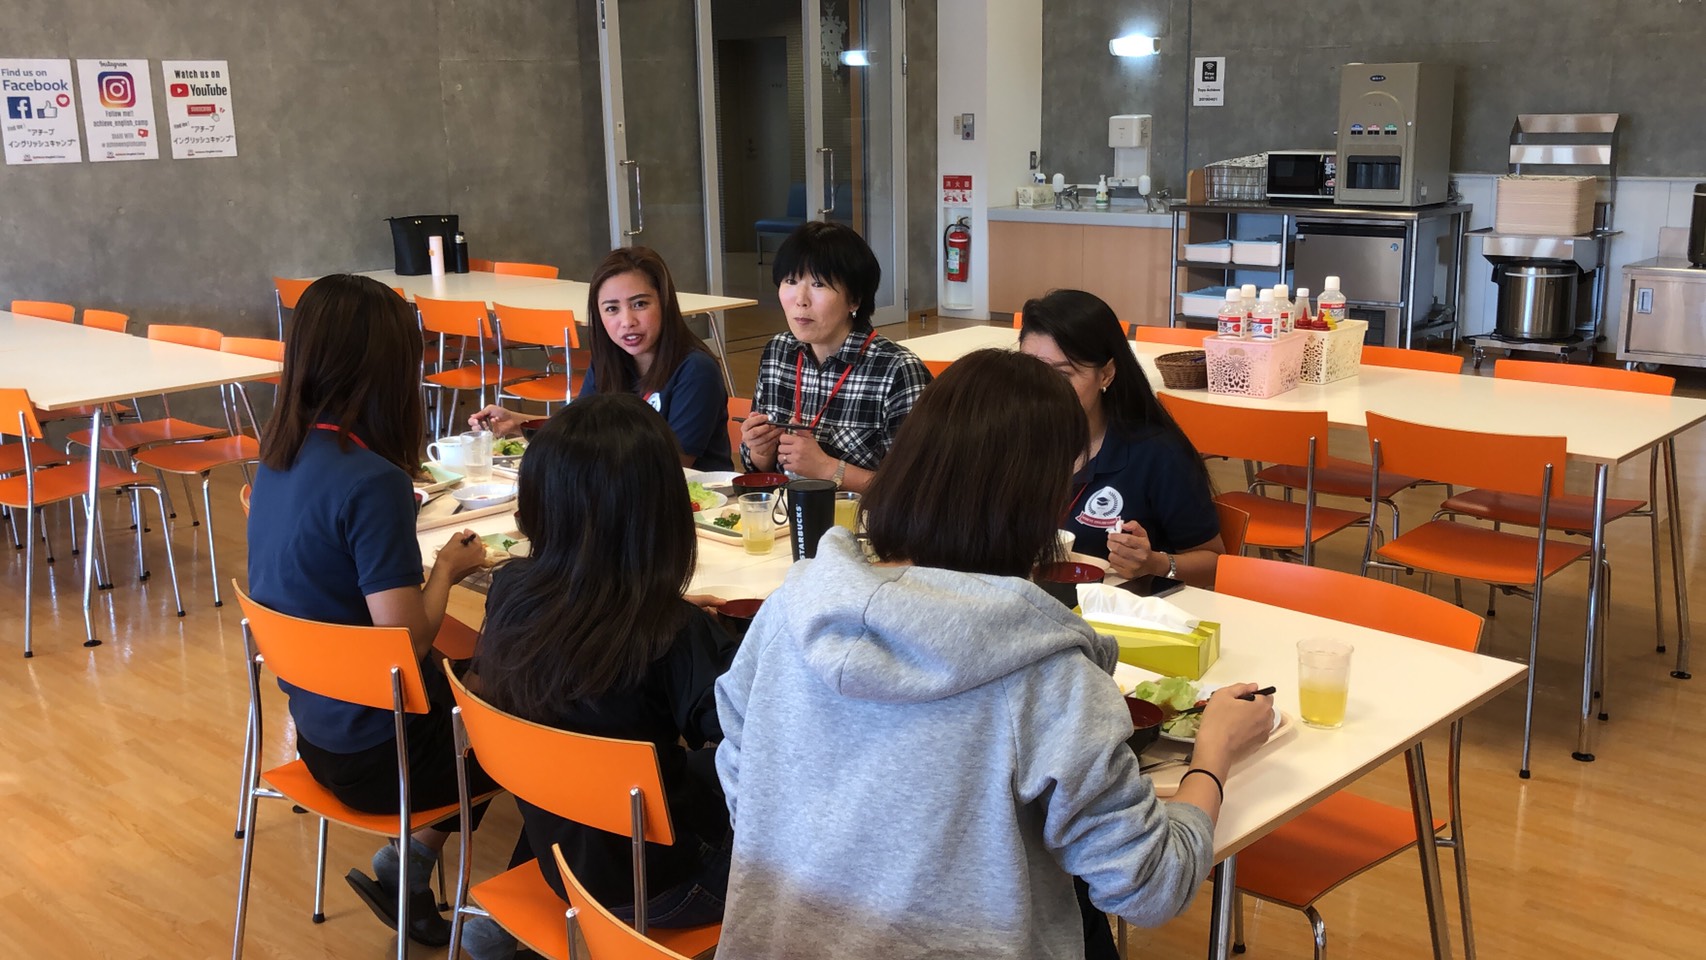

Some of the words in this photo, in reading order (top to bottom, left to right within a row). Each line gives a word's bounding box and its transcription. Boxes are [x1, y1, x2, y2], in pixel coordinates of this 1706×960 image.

[99, 60, 128, 69] Instagram
[1, 68, 20, 77] Find
[174, 70, 198, 79] Watch
[200, 70, 209, 78] us
[211, 70, 220, 78] on
[3, 79, 69, 91] Facebook
[190, 83, 227, 96] YouTube
[796, 505, 806, 560] STARBUCKS
